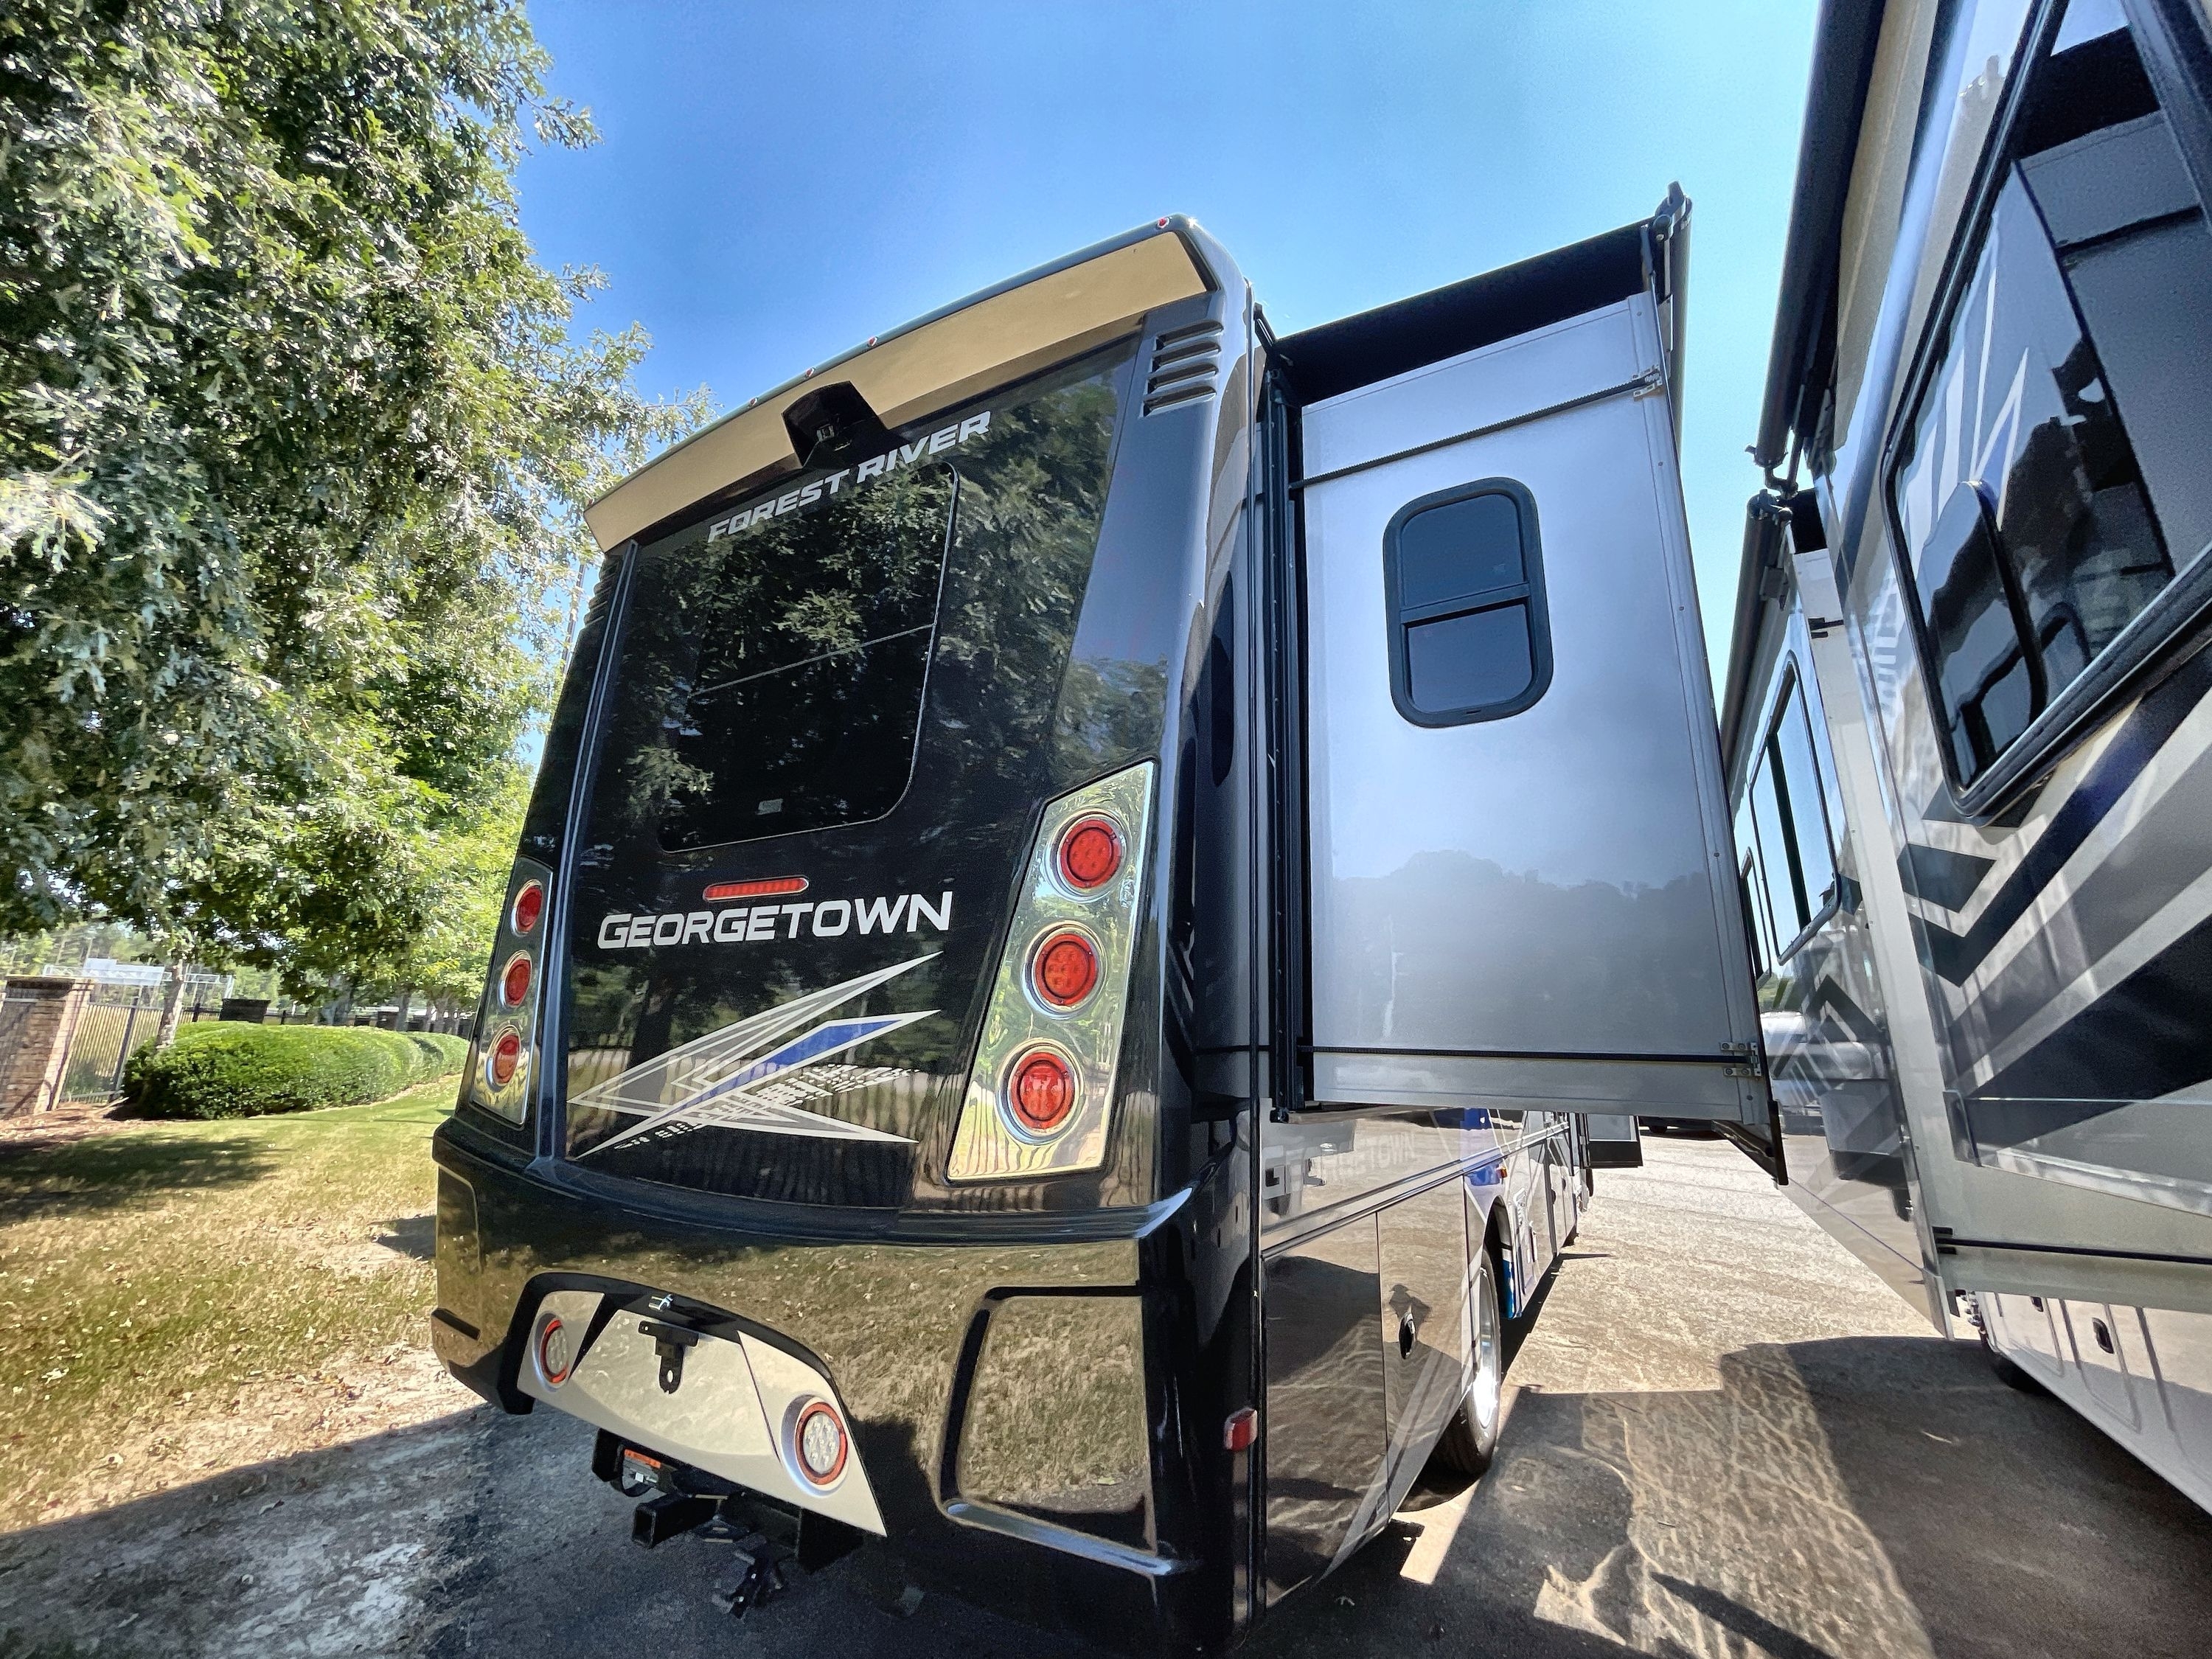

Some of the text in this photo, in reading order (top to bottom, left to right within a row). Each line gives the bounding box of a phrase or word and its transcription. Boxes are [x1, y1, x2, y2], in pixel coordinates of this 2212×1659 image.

[708, 411, 991, 543] FOREST RIVER
[598, 891, 953, 949] GEORGETOWN
